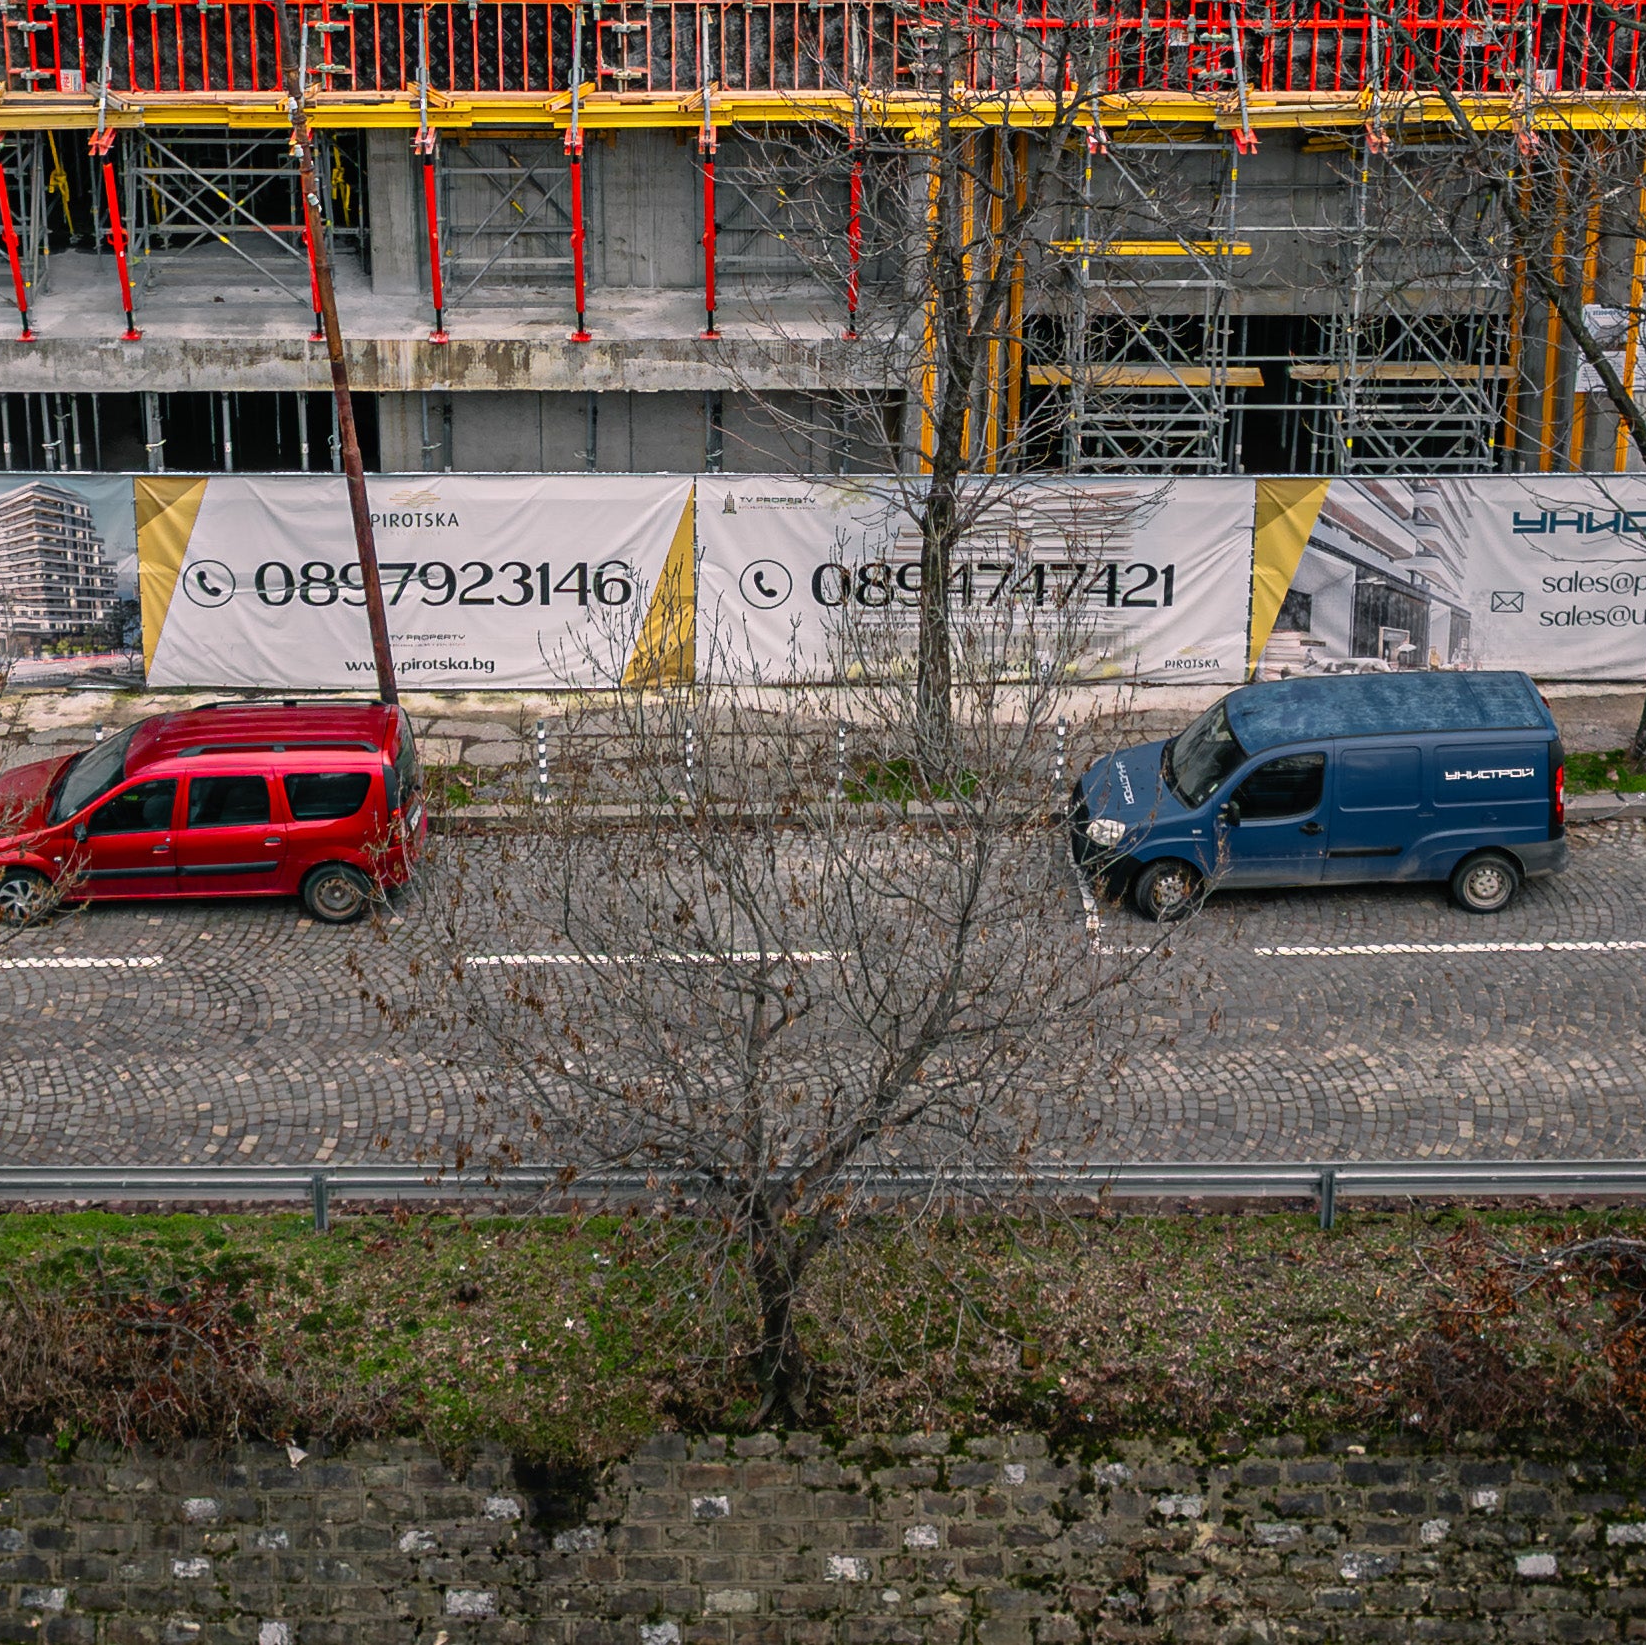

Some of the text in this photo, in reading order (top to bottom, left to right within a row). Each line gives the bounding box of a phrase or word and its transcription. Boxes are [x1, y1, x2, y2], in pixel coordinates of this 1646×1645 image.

[370, 513, 460, 528] PIROTSKA
[254, 560, 634, 607] 0897923146
[345, 657, 495, 674] ww.pirotska.bg
[1165, 659, 1220, 669] PIROTSKA
[1445, 768, 1534, 780] УНИСТРОЙ
